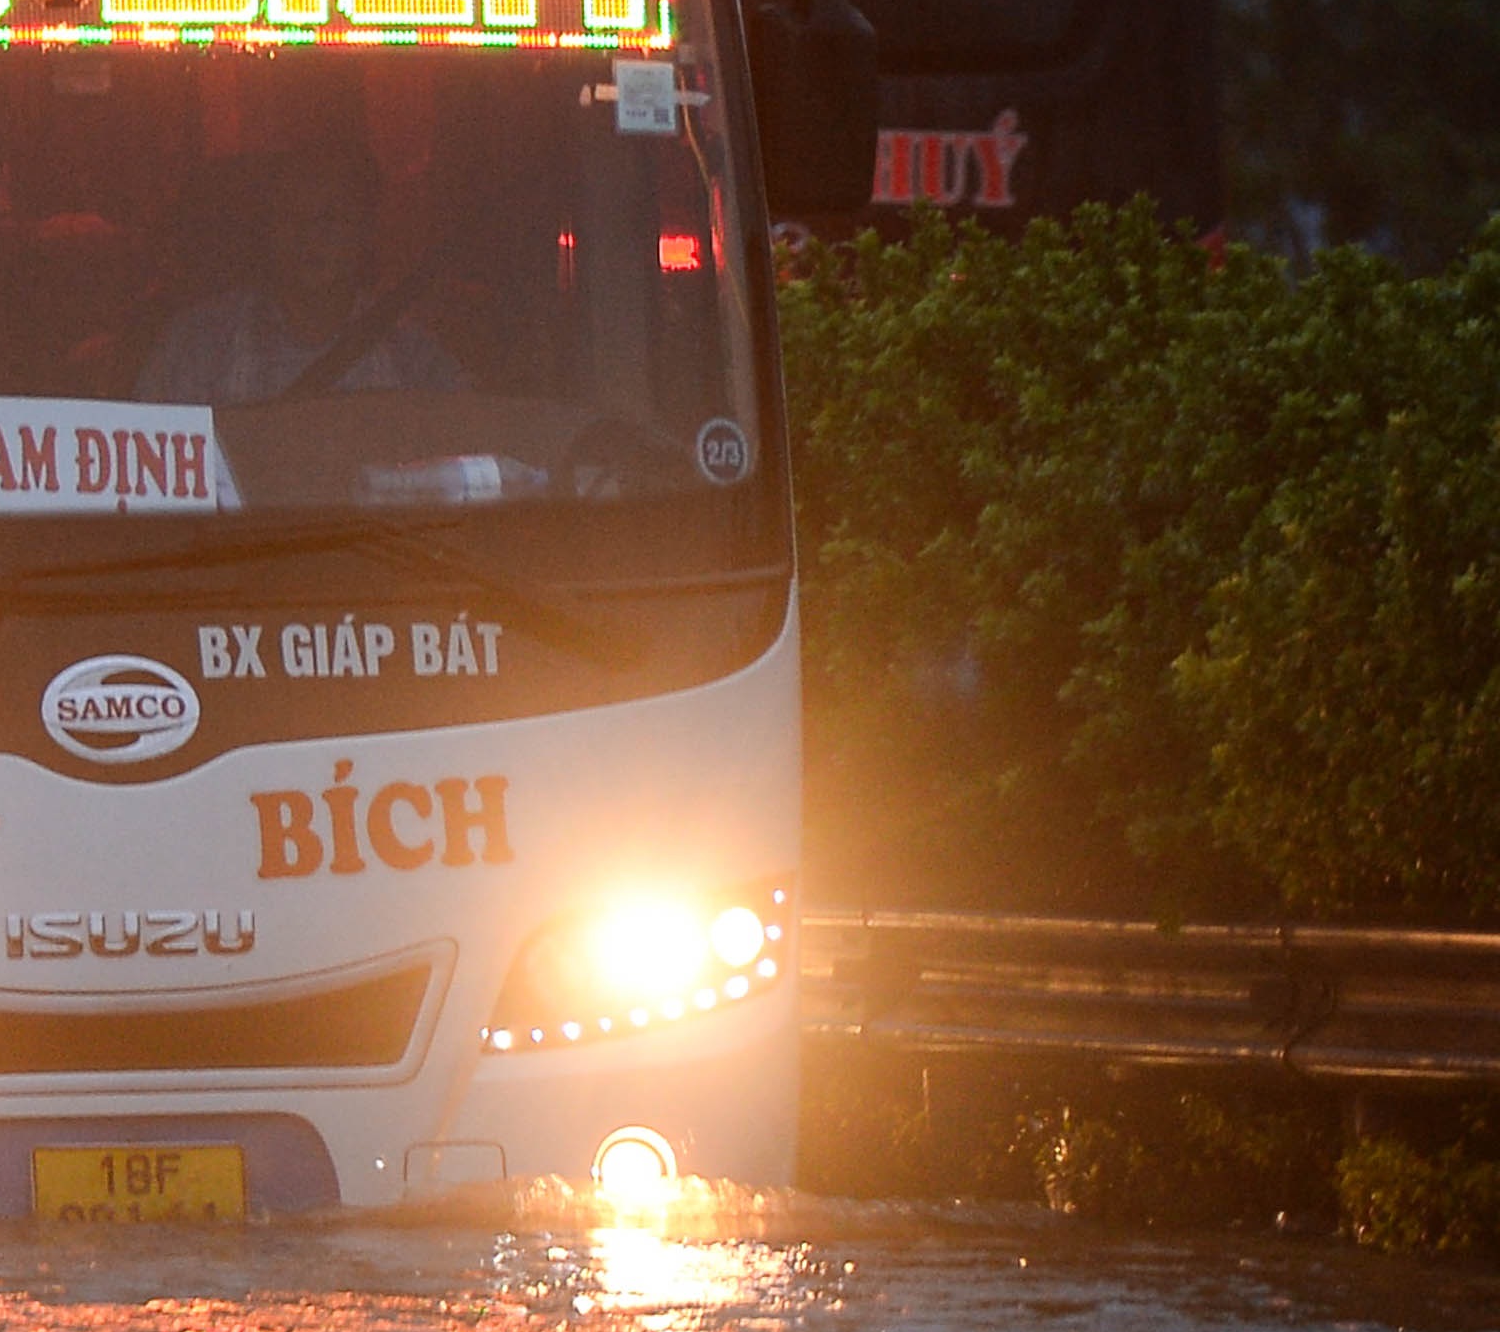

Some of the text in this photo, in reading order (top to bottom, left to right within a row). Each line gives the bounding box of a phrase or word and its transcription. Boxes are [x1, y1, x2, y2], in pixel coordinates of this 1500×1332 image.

[75, 428, 209, 514] ĐỊNH
[199, 614, 502, 678] BX GIÁP BÁT
[57, 693, 186, 723] SAMCO
[250, 760, 515, 880] BÍCH
[6, 910, 256, 959] ISUZU
[102, 1154, 182, 1196] 18F
